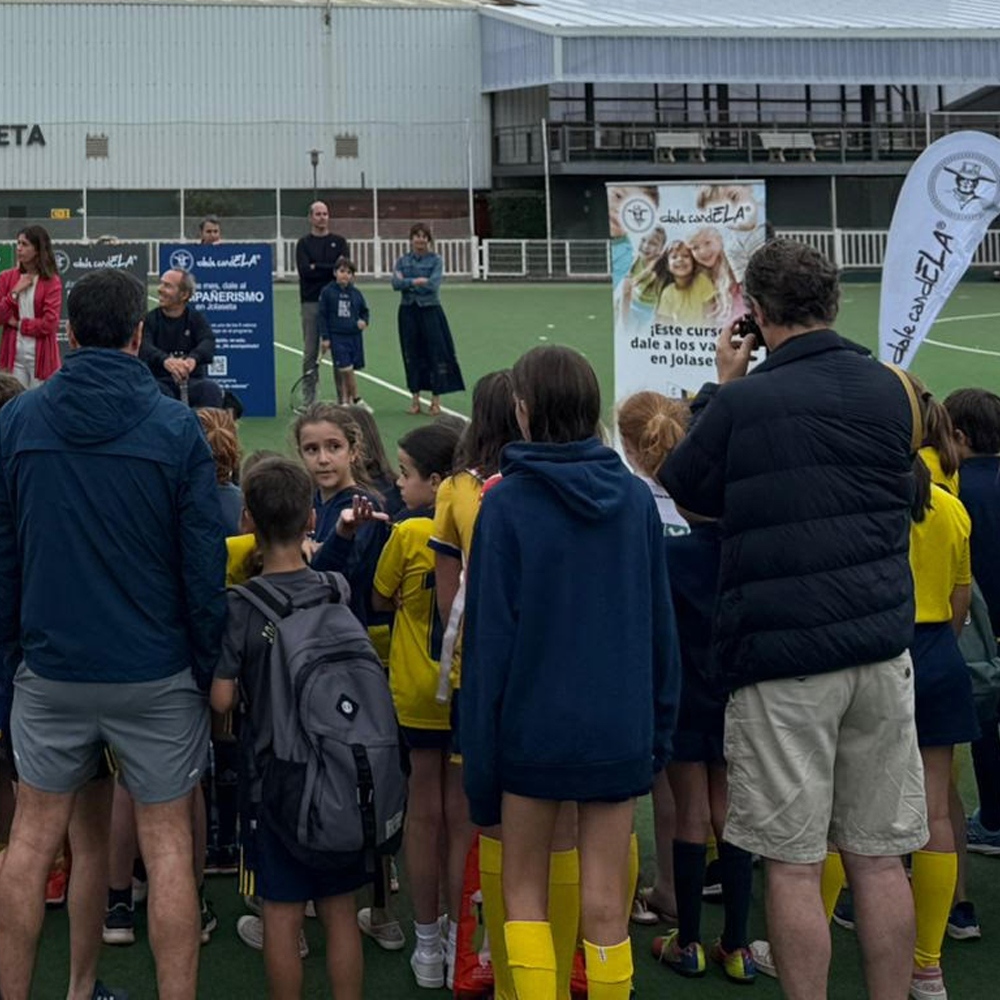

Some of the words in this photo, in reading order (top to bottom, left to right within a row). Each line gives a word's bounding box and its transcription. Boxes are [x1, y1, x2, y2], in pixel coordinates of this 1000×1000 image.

[659, 209, 686, 225] dale
[189, 289, 265, 303] PAÑERISMO
[650, 323, 683, 337] ¡Este
[630, 337, 660, 350] dale
[663, 340, 672, 350] a
[675, 338, 696, 351] los
[650, 354, 667, 365] en
[670, 353, 717, 368] Jolase
